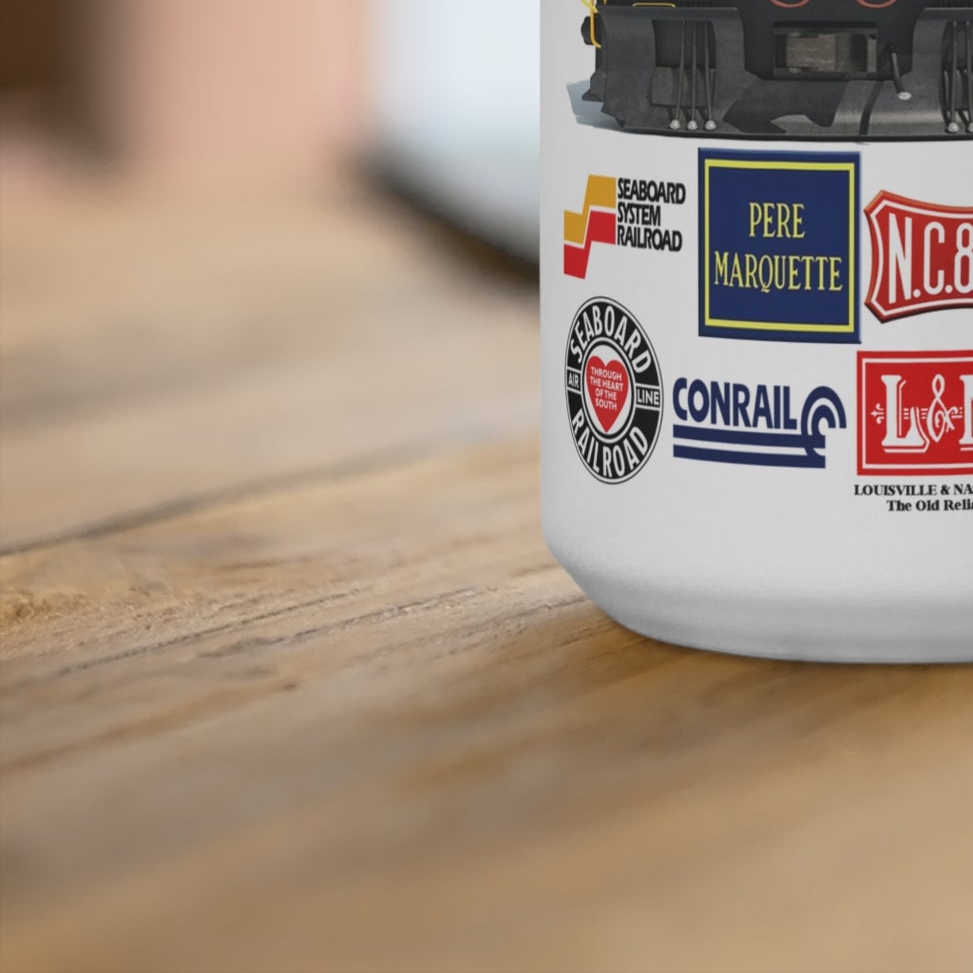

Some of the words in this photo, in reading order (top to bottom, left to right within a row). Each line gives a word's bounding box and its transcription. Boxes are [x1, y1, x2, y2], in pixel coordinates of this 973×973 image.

[617, 177, 686, 205] SEABOARD
[617, 202, 661, 226] SYSTEM
[749, 202, 806, 238] PERE
[617, 225, 683, 252] RAILROAD
[714, 251, 843, 293] MARQUETTE
[570, 305, 652, 373] SEABOARD
[590, 376, 601, 387] THE
[602, 379, 624, 392] HEART
[591, 367, 622, 381] THROUGH
[568, 372, 580, 388] AIR
[637, 388, 660, 405] LINE
[595, 388, 604, 398] OF
[605, 390, 617, 400] THE
[595, 398, 617, 411] SOUTH
[672, 377, 798, 430] CONRAIL
[571, 408, 648, 477] RAILROAD
[854, 484, 937, 496] LOUISVILLE
[940, 484, 950, 496] &
[887, 500, 912, 512] The
[916, 499, 940, 511] Old
